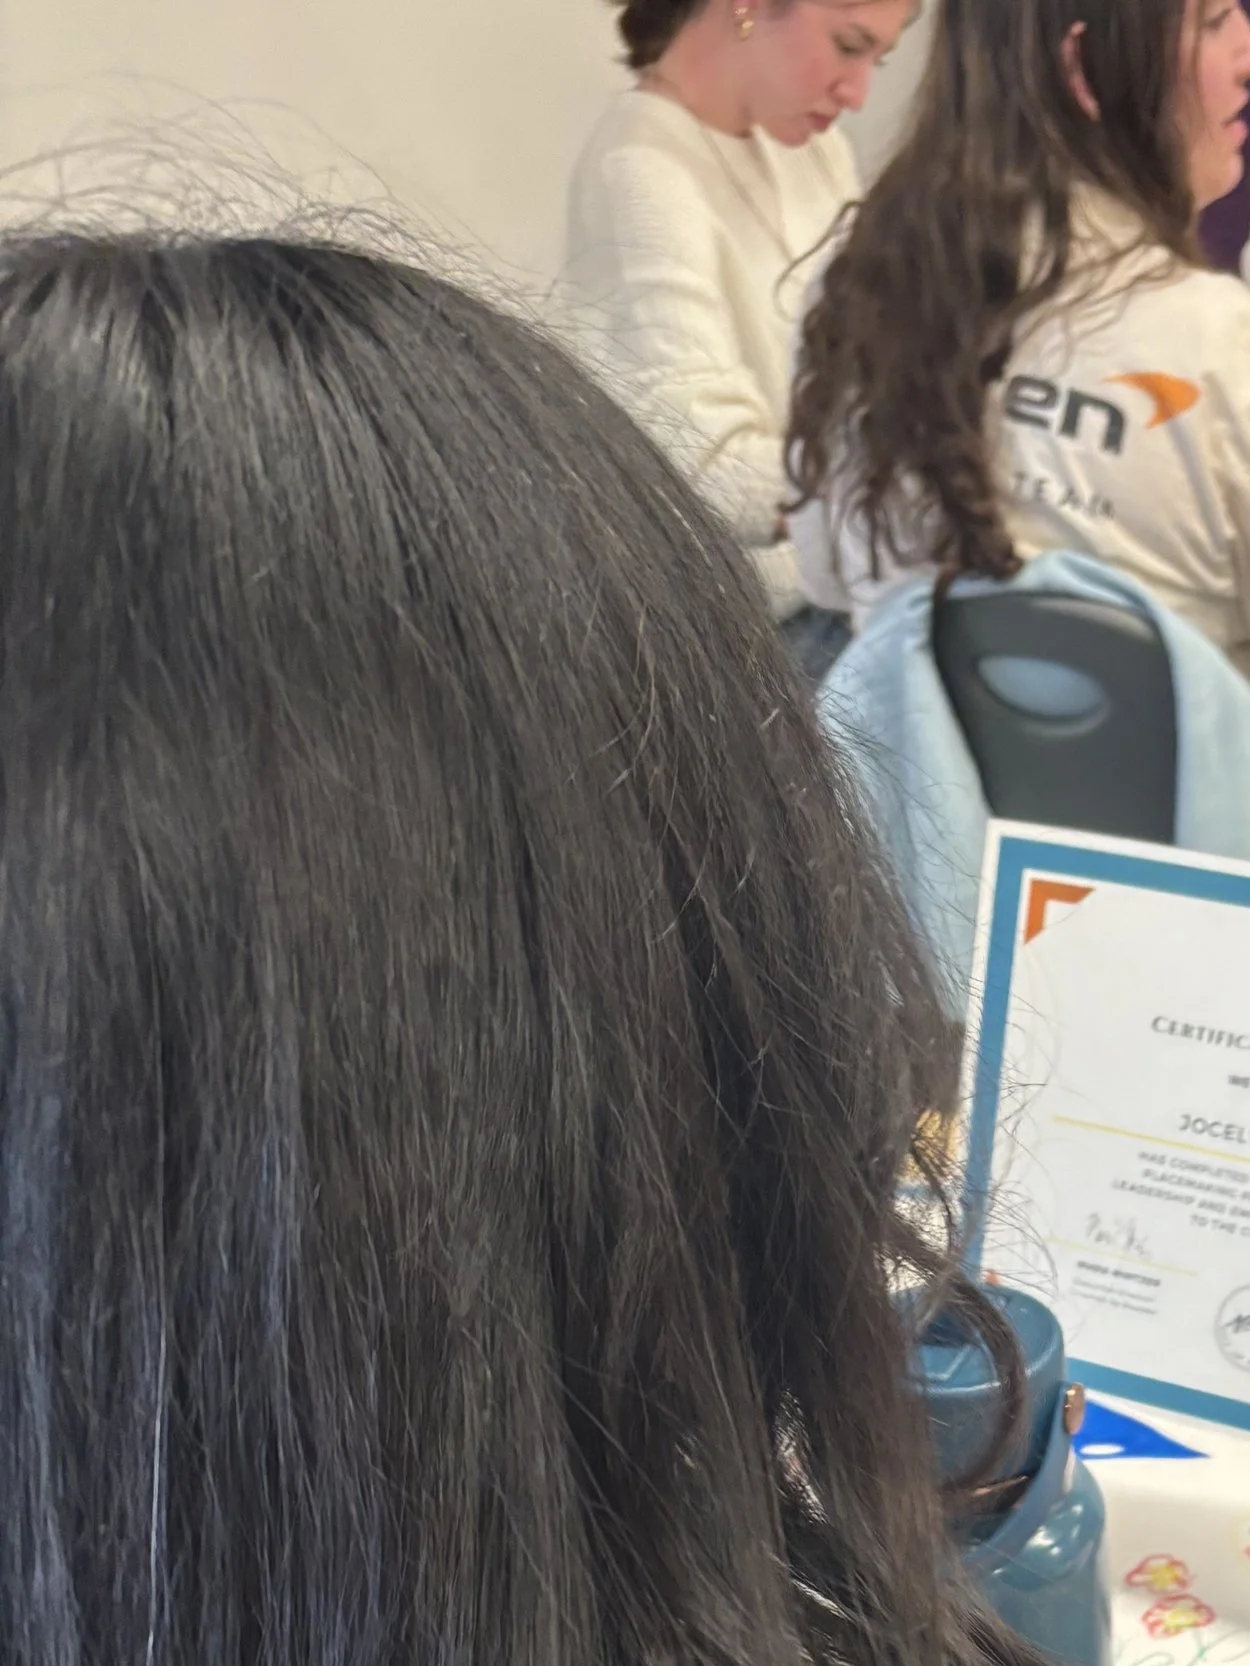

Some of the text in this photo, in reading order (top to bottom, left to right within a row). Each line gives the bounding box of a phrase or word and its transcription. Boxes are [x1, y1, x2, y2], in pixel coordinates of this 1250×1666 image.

[1169, 1157, 1249, 1183] COMPLETED
[1112, 1179, 1195, 1206] LEADERSHIP
[1198, 1201, 1226, 1214] AND
[1190, 1213, 1208, 1227] TO
[1211, 1218, 1237, 1234] THE
